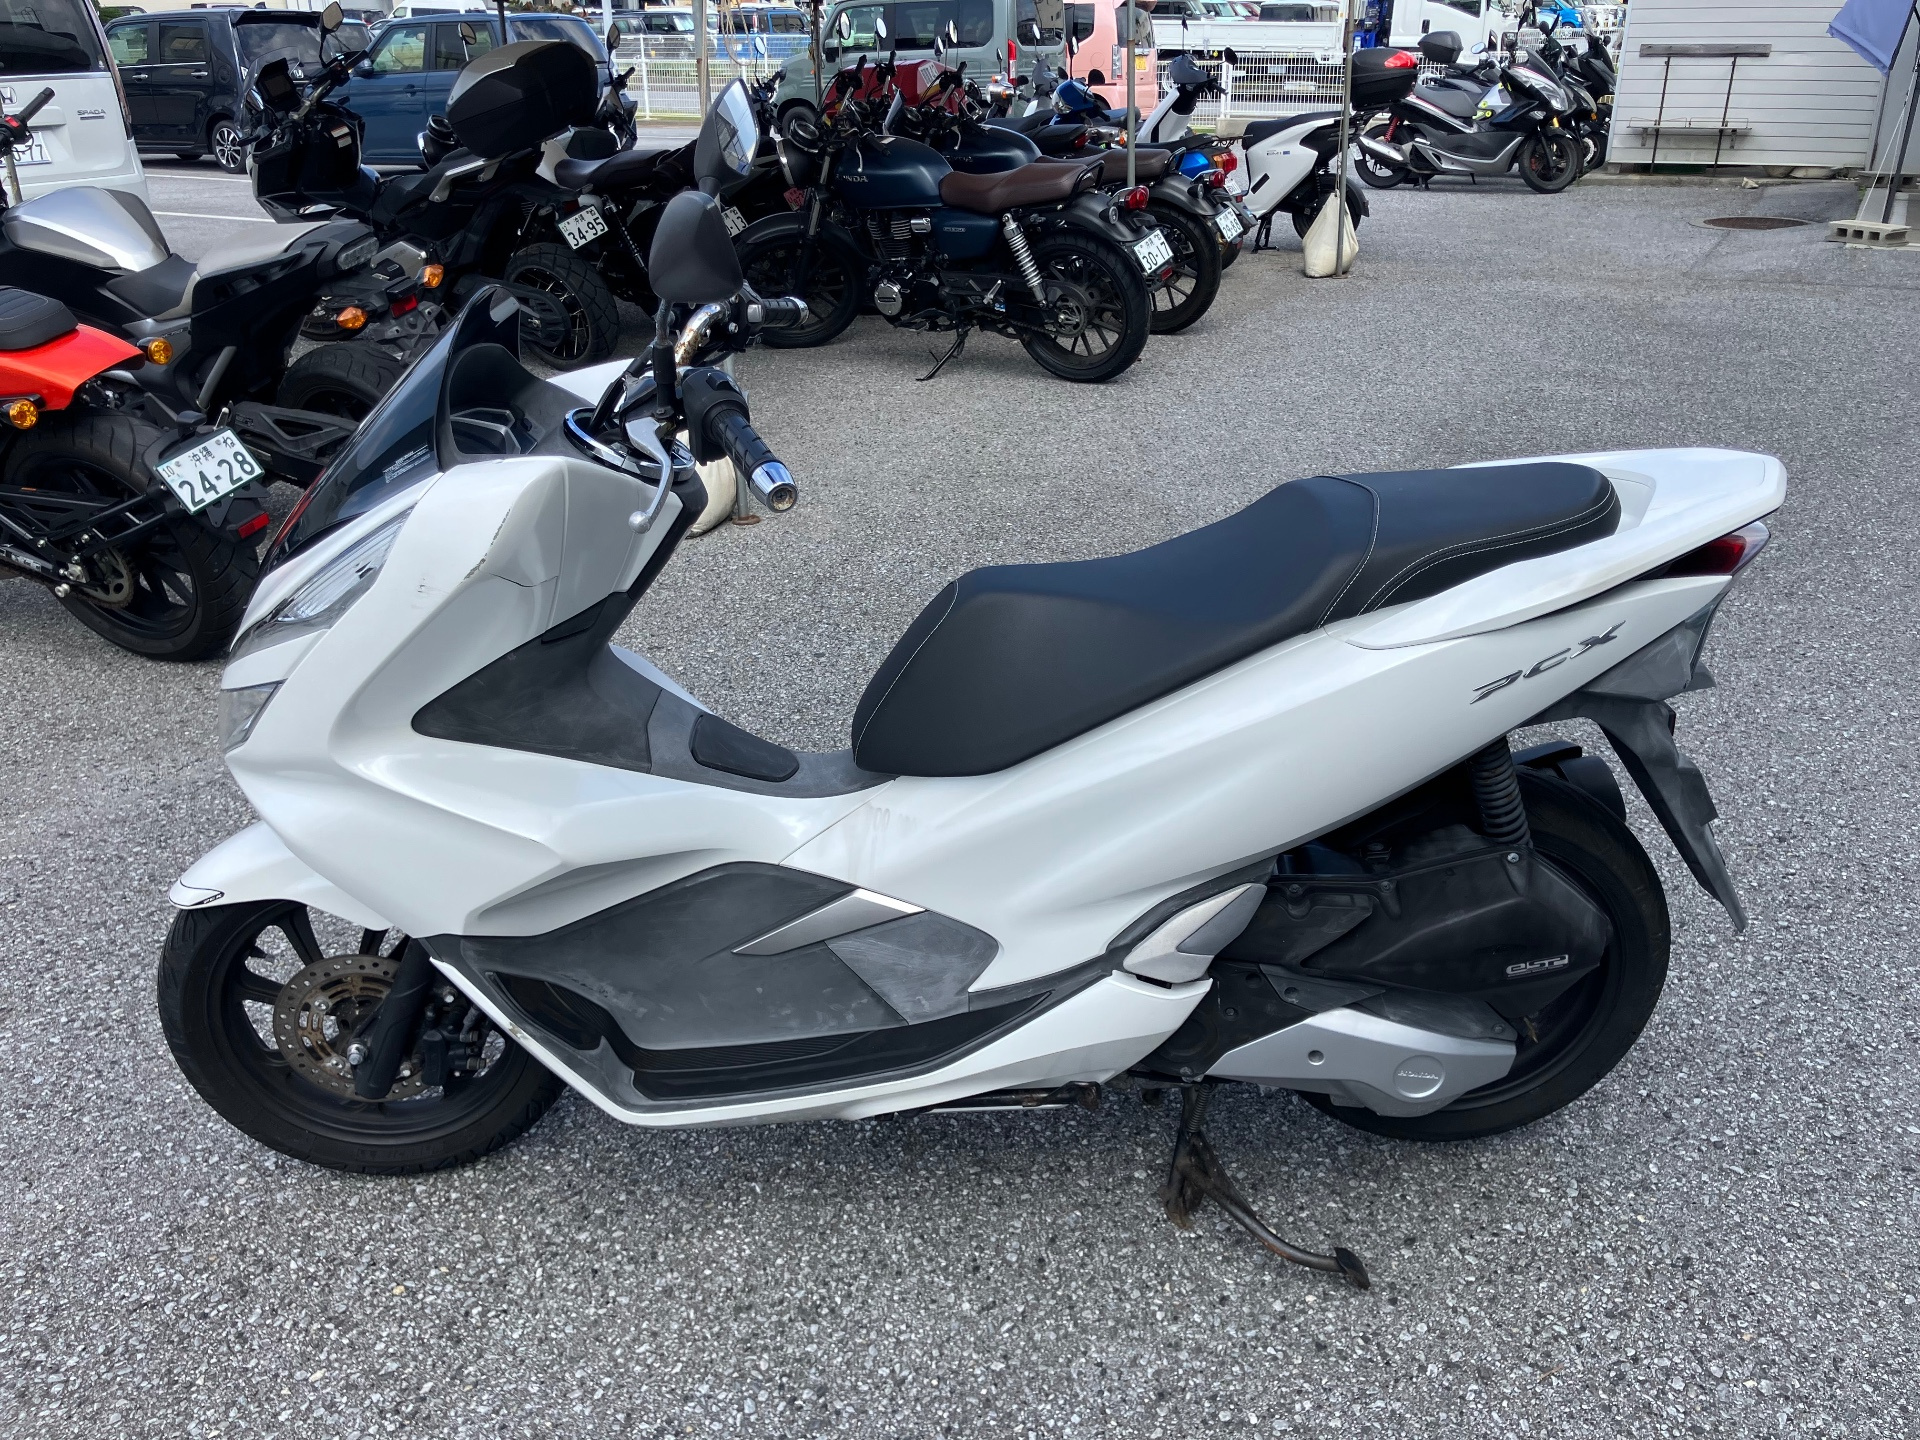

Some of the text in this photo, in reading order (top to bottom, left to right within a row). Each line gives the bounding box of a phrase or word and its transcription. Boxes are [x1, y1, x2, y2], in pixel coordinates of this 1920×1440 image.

[568, 217, 606, 246] 34-95
[1142, 241, 1170, 271] 30-17
[162, 465, 175, 478] 10
[188, 445, 215, 467] 沖縄
[178, 451, 255, 508] 24-28
[1470, 620, 1626, 704] PCX
